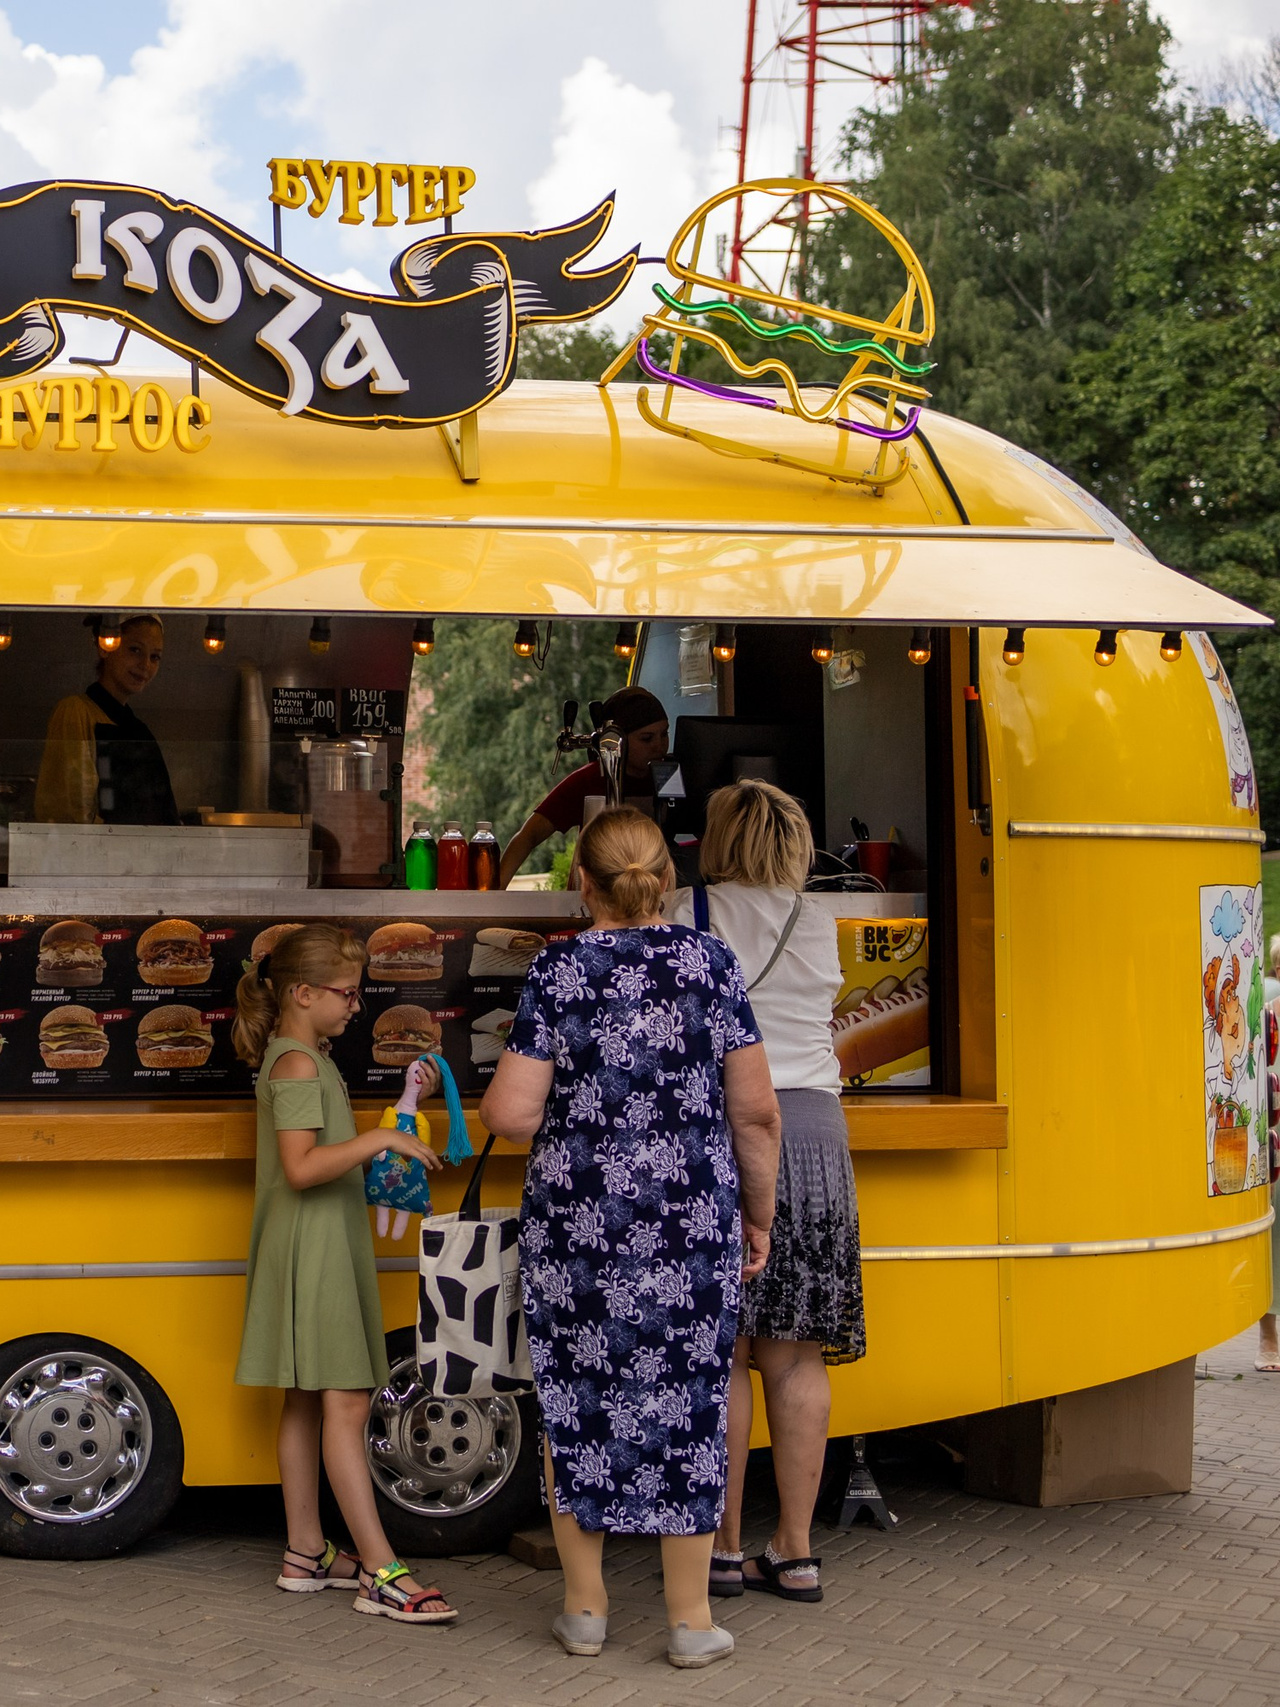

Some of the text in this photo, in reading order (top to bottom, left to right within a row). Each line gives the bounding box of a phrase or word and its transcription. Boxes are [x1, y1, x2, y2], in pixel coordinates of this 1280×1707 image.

[268, 157, 477, 227] БУРГЕР
[70, 199, 409, 418] КОЗА
[273, 698, 303, 707] ТАРХУН
[310, 700, 335, 719] 100
[274, 716, 314, 725] АПЕЛЬСИН
[352, 703, 386, 728] 159
[864, 925, 889, 944] ВК
[864, 944, 891, 962] УС
[30, 994, 53, 1002] РЖАНОЙ
[31, 1070, 57, 1078] ДВОЙНОЙ
